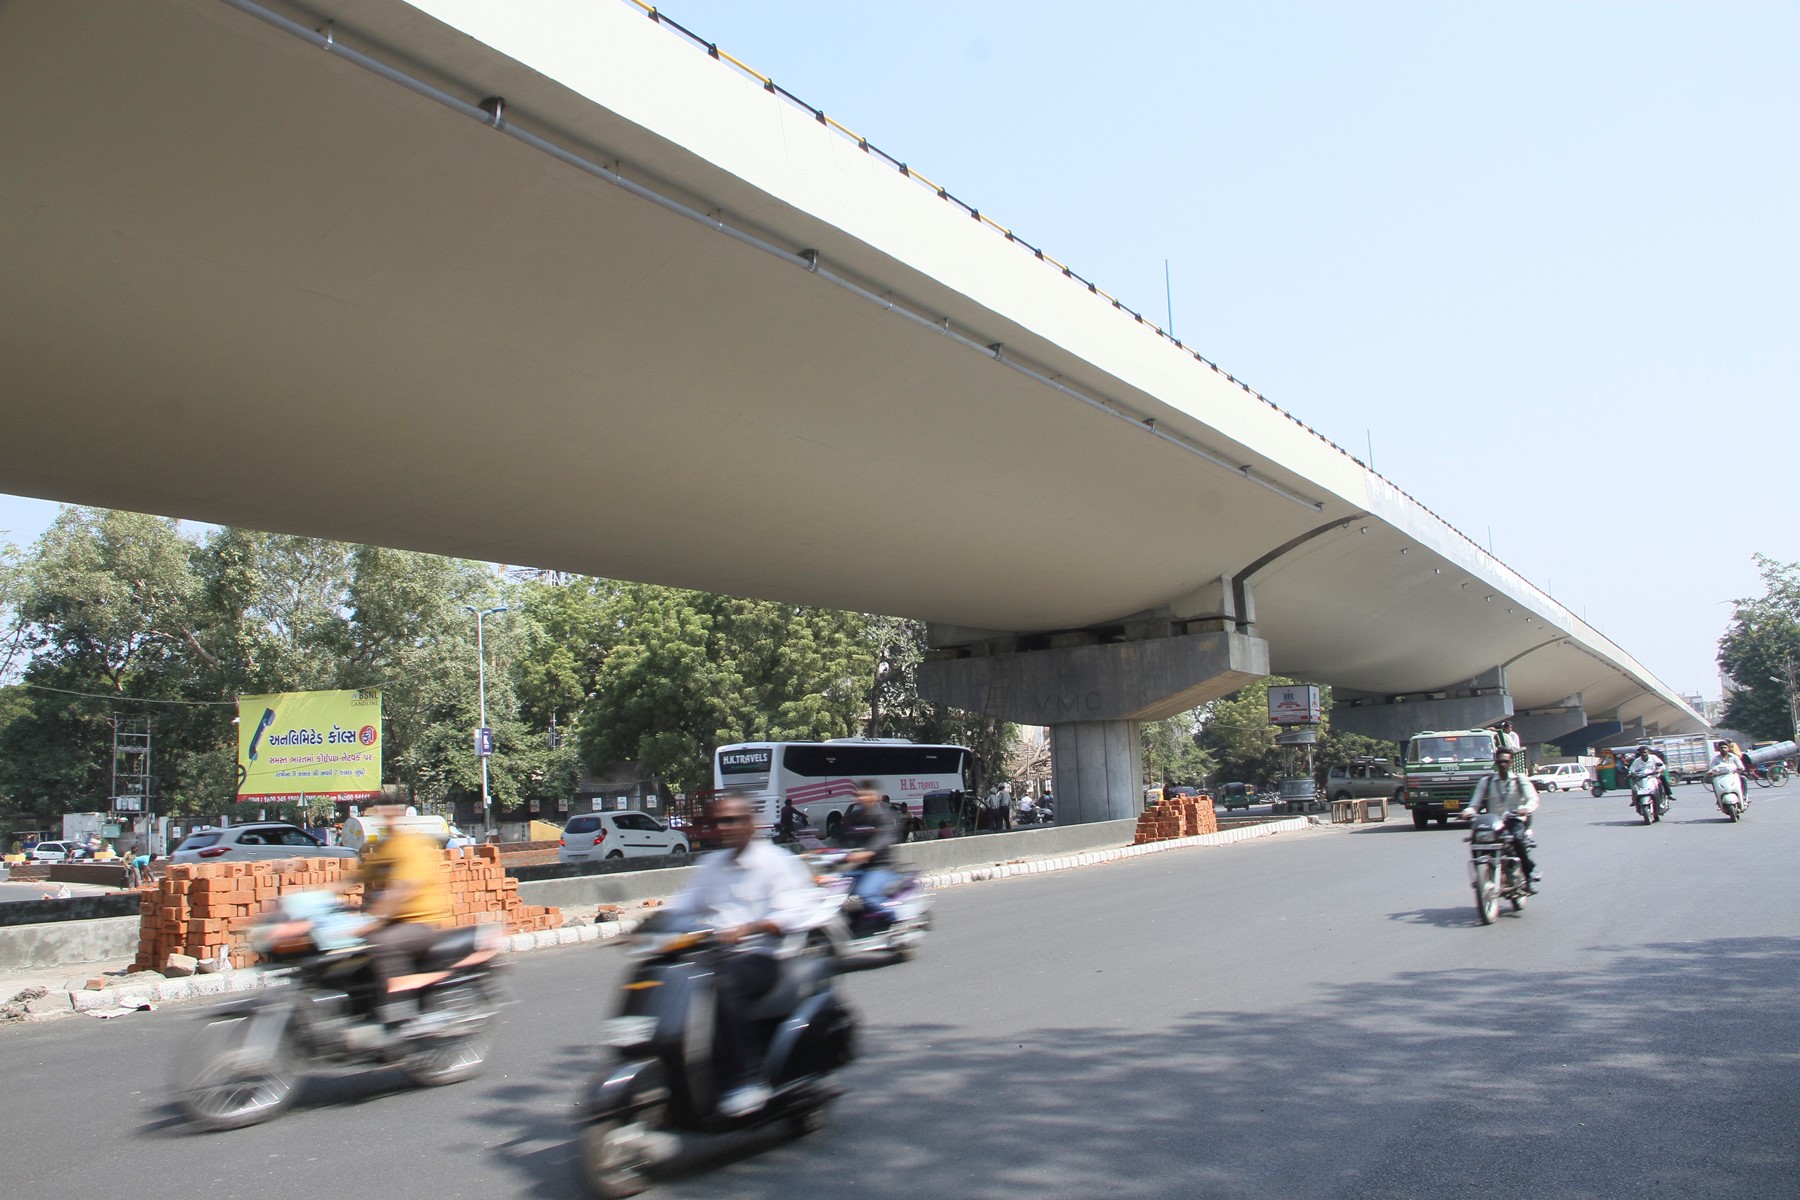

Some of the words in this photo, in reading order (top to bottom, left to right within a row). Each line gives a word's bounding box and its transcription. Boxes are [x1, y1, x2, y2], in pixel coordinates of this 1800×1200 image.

[359, 690, 378, 700] BSNL
[269, 729, 323, 746] અનલિમિટેડ
[328, 724, 356, 744] કૉલ્સ
[269, 756, 288, 764] સમસ્ત
[290, 753, 314, 763] ભારતમાં
[918, 781, 940, 790] TRAVELS
